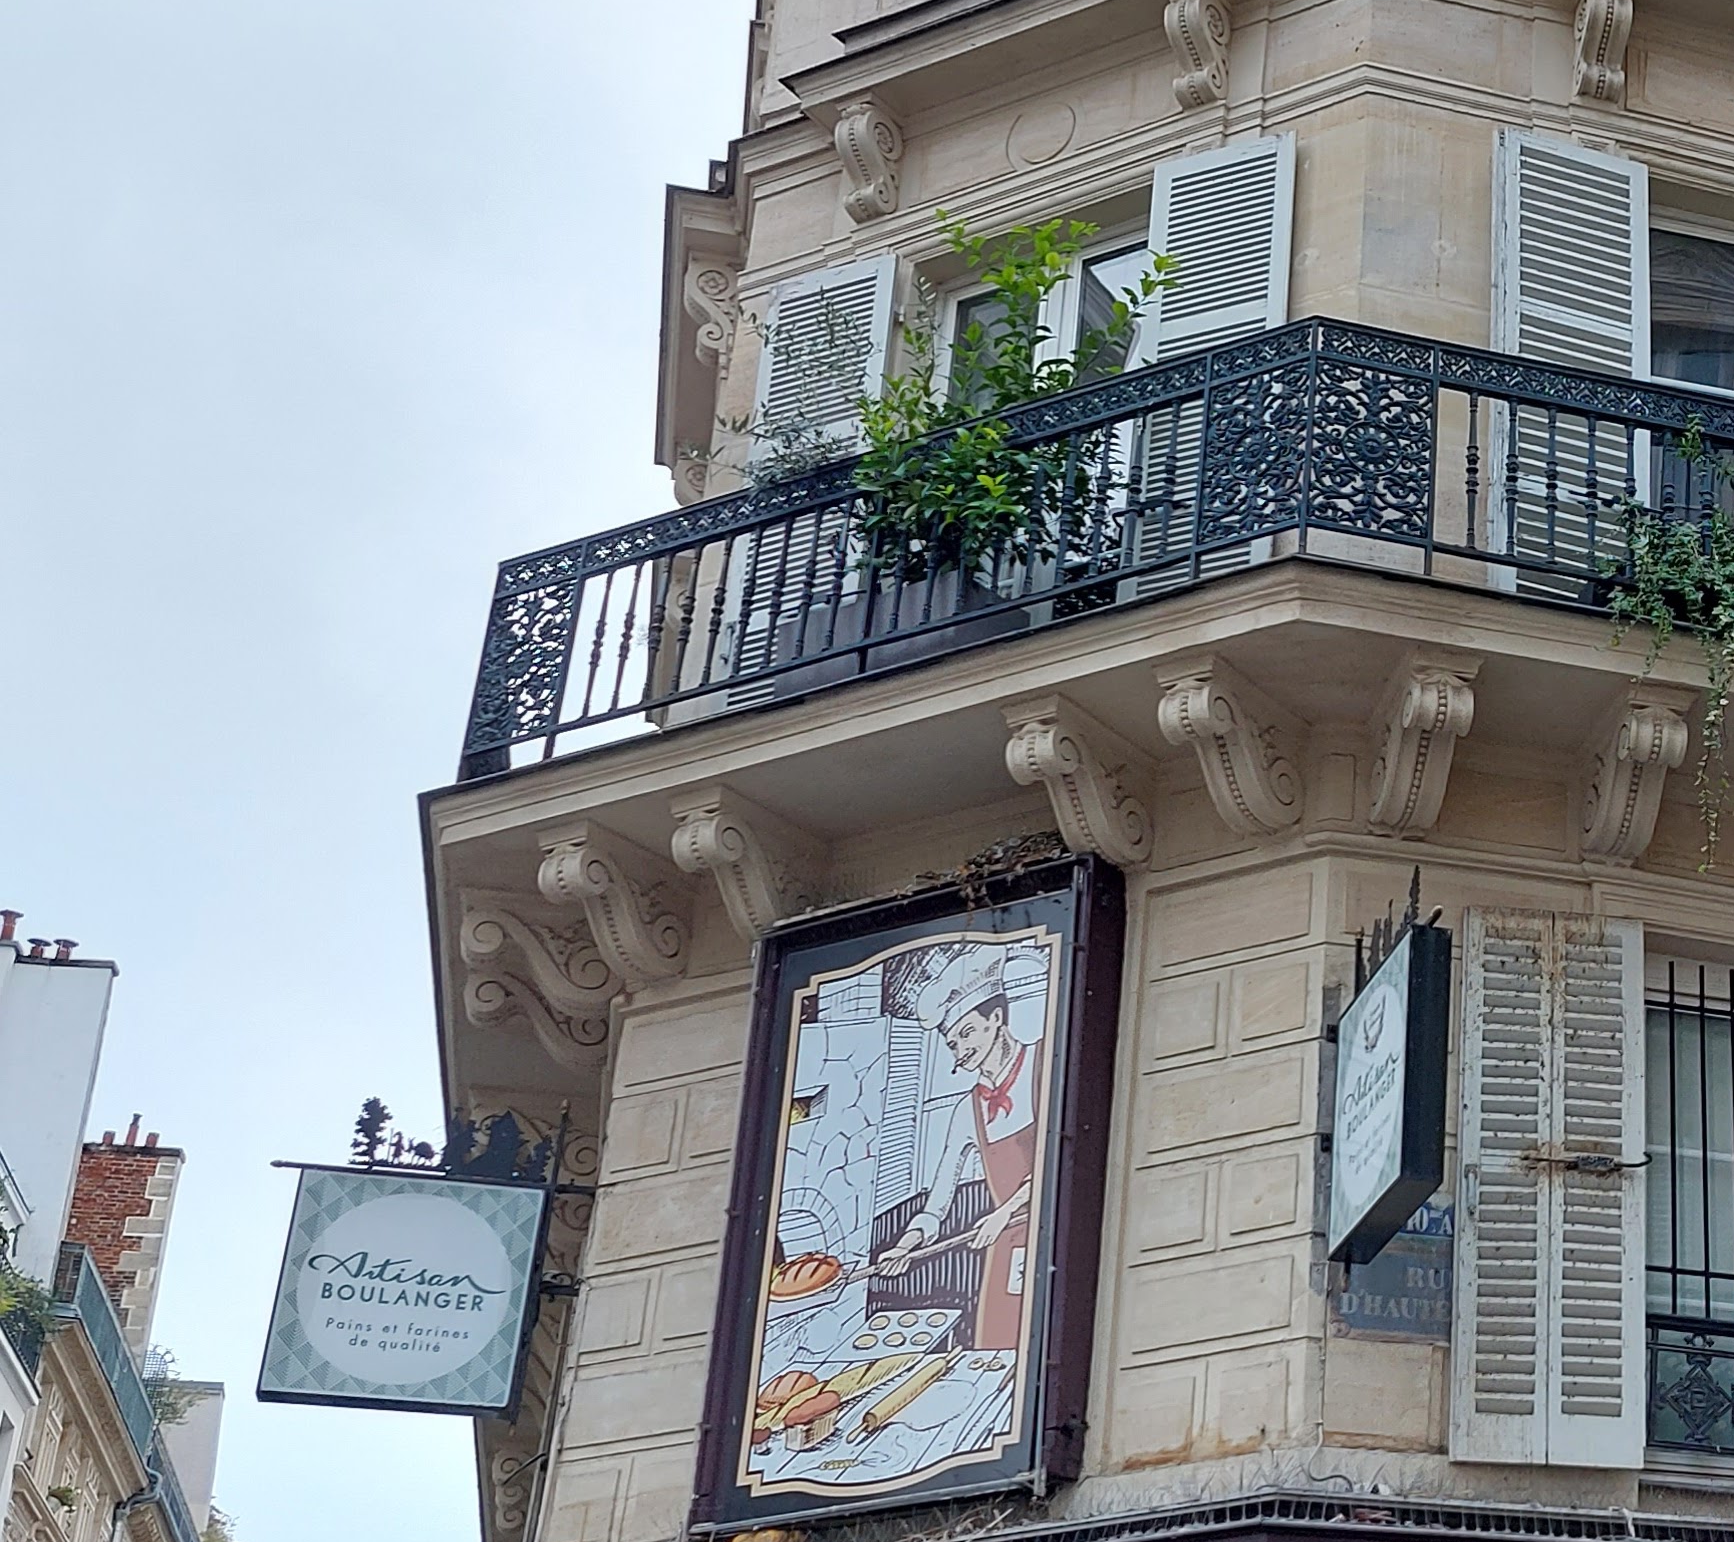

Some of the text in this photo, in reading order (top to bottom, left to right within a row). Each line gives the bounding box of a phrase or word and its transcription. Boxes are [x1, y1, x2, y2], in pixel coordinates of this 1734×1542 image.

[308, 1251, 506, 1294] Artisan
[321, 1282, 485, 1312] BOULANGER
[325, 1317, 470, 1340] Pains et farines
[348, 1334, 441, 1353] de qualité
